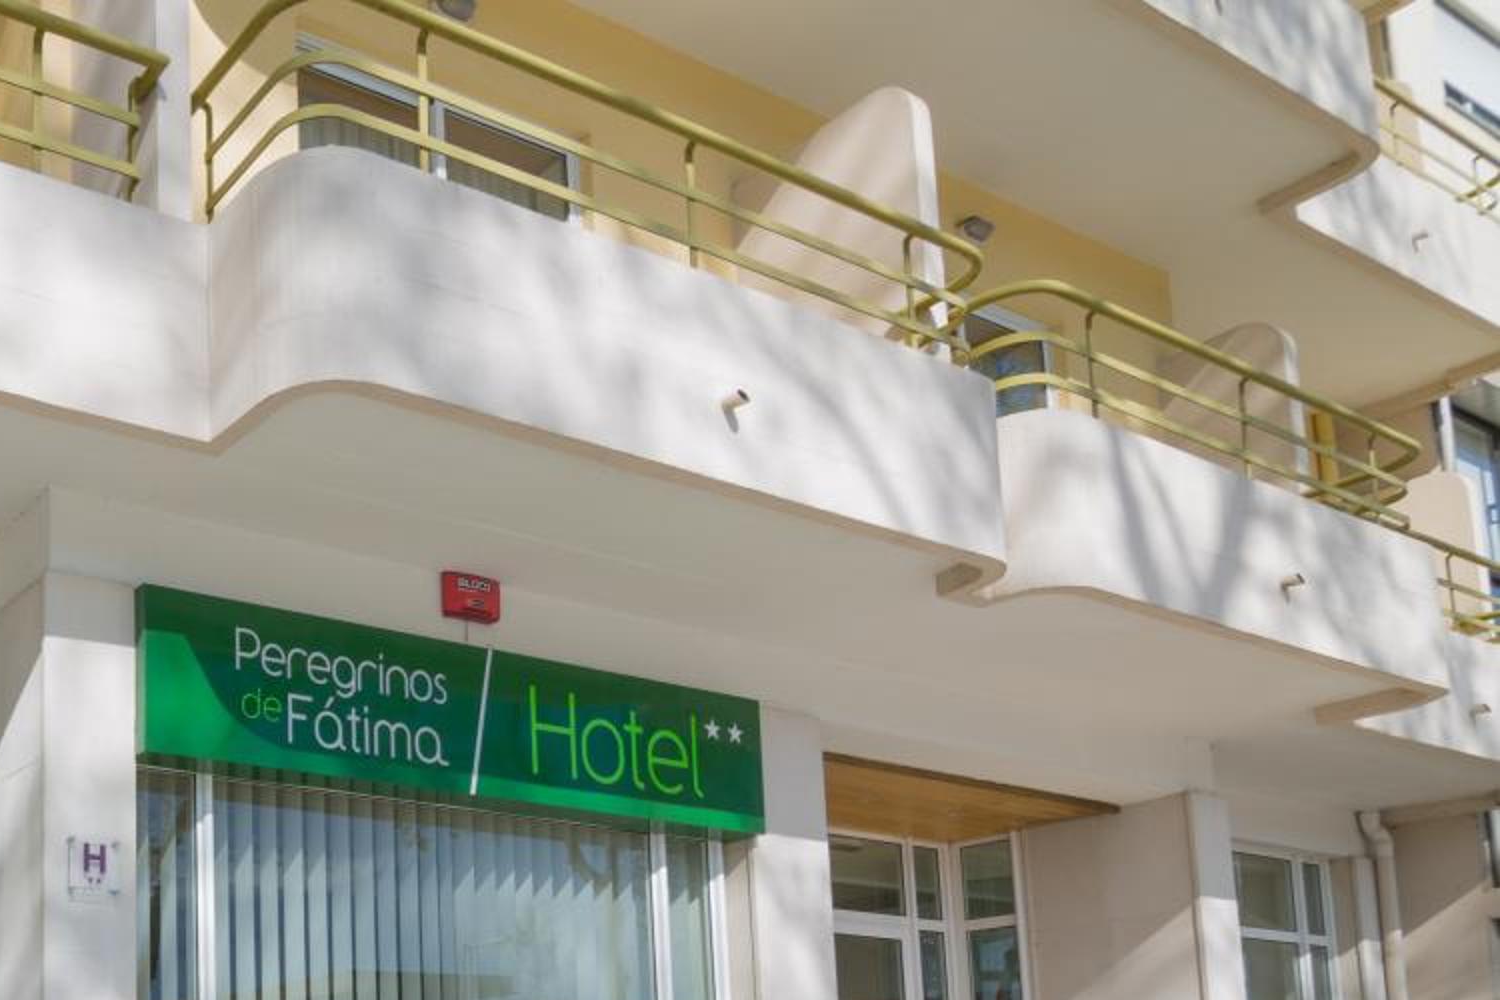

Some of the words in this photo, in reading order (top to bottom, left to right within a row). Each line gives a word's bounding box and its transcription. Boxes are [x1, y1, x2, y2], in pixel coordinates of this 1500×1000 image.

[235, 625, 448, 704] Peregrinos
[241, 687, 283, 722] de
[287, 692, 450, 767] Fátima
[529, 684, 705, 799] Hotel
[83, 842, 106, 874] H
